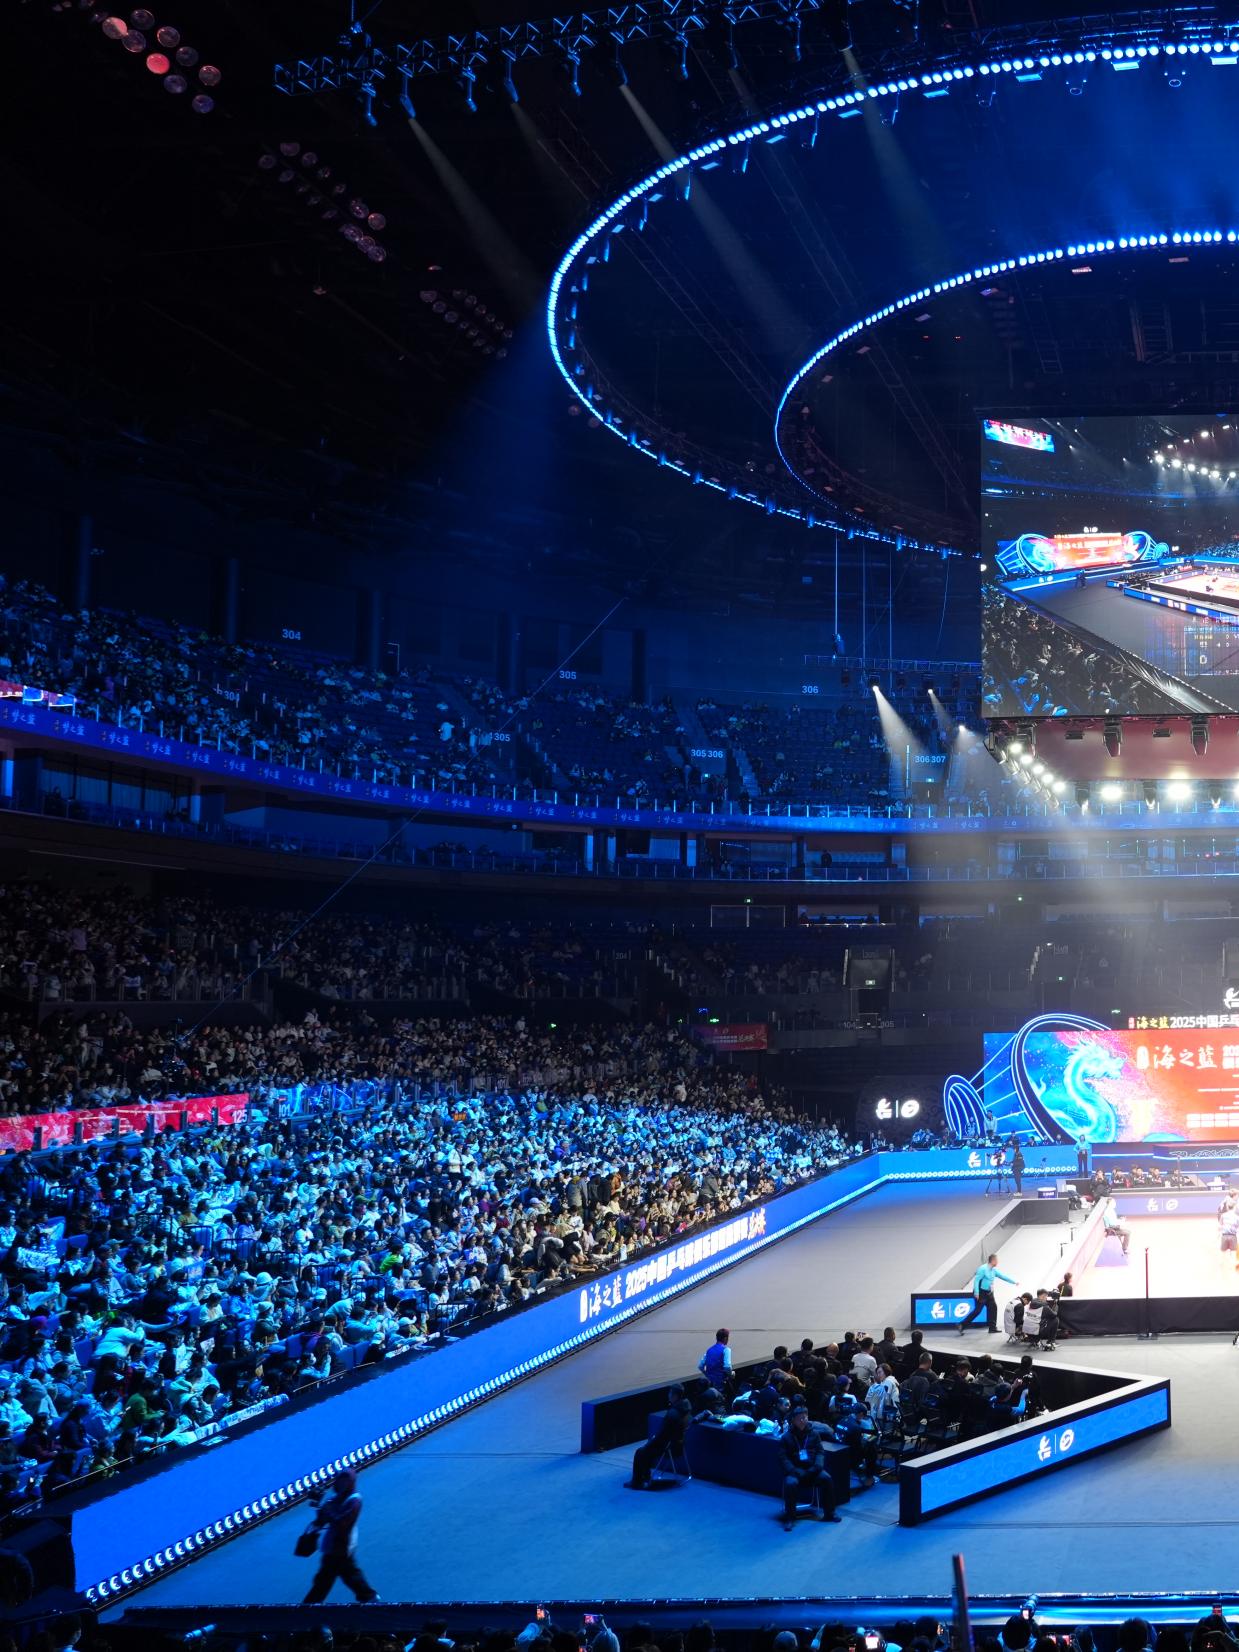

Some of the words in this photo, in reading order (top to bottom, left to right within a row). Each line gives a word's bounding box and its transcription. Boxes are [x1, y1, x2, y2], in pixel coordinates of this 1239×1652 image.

[282, 628, 301, 640] 304
[560, 670, 577, 680] 305
[802, 685, 819, 694] 306
[494, 732, 511, 742] 305
[691, 749, 706, 758] 305
[707, 750, 724, 759] 306
[1153, 1044, 1217, 1069] 海之蓝
[231, 1109, 248, 1123] 125
[589, 1273, 623, 1318] 海之蓝
